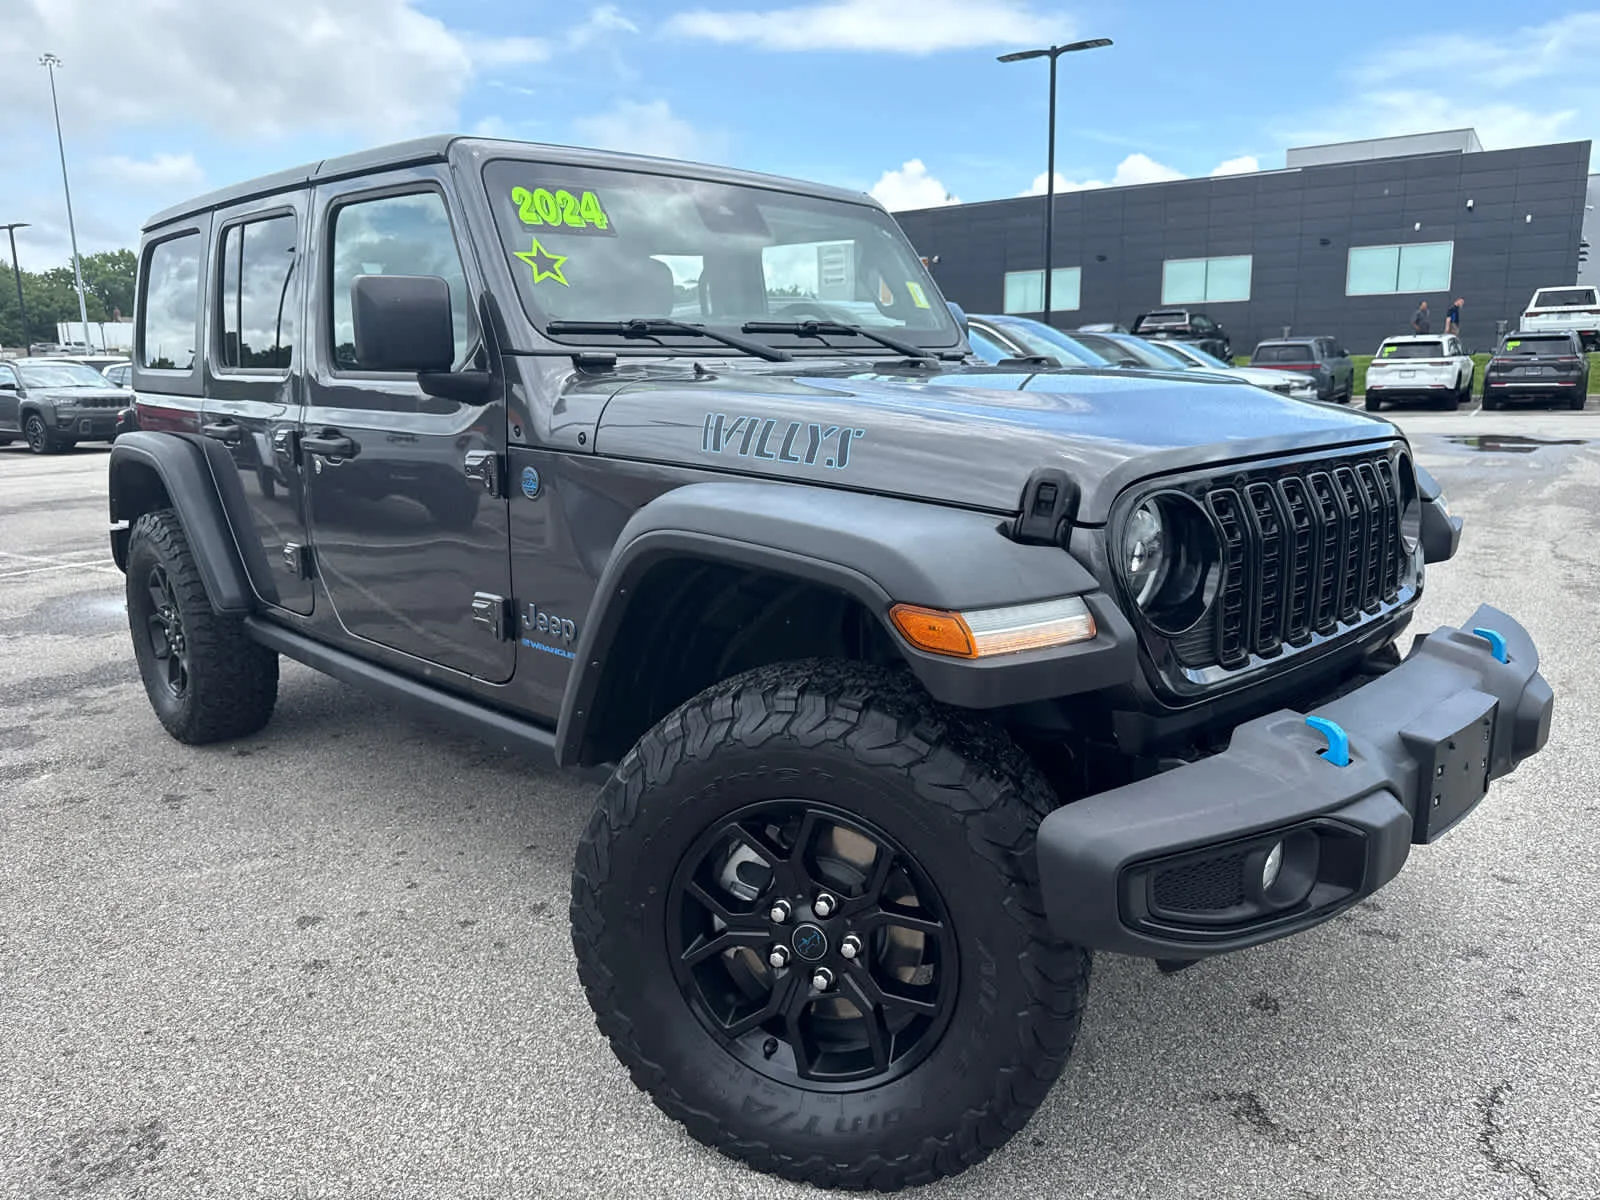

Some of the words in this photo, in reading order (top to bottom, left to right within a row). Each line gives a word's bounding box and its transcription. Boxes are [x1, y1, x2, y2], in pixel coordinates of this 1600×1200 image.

[511, 186, 609, 230] 2024
[701, 412, 866, 470] WILLYS
[521, 602, 576, 646] Jeep
